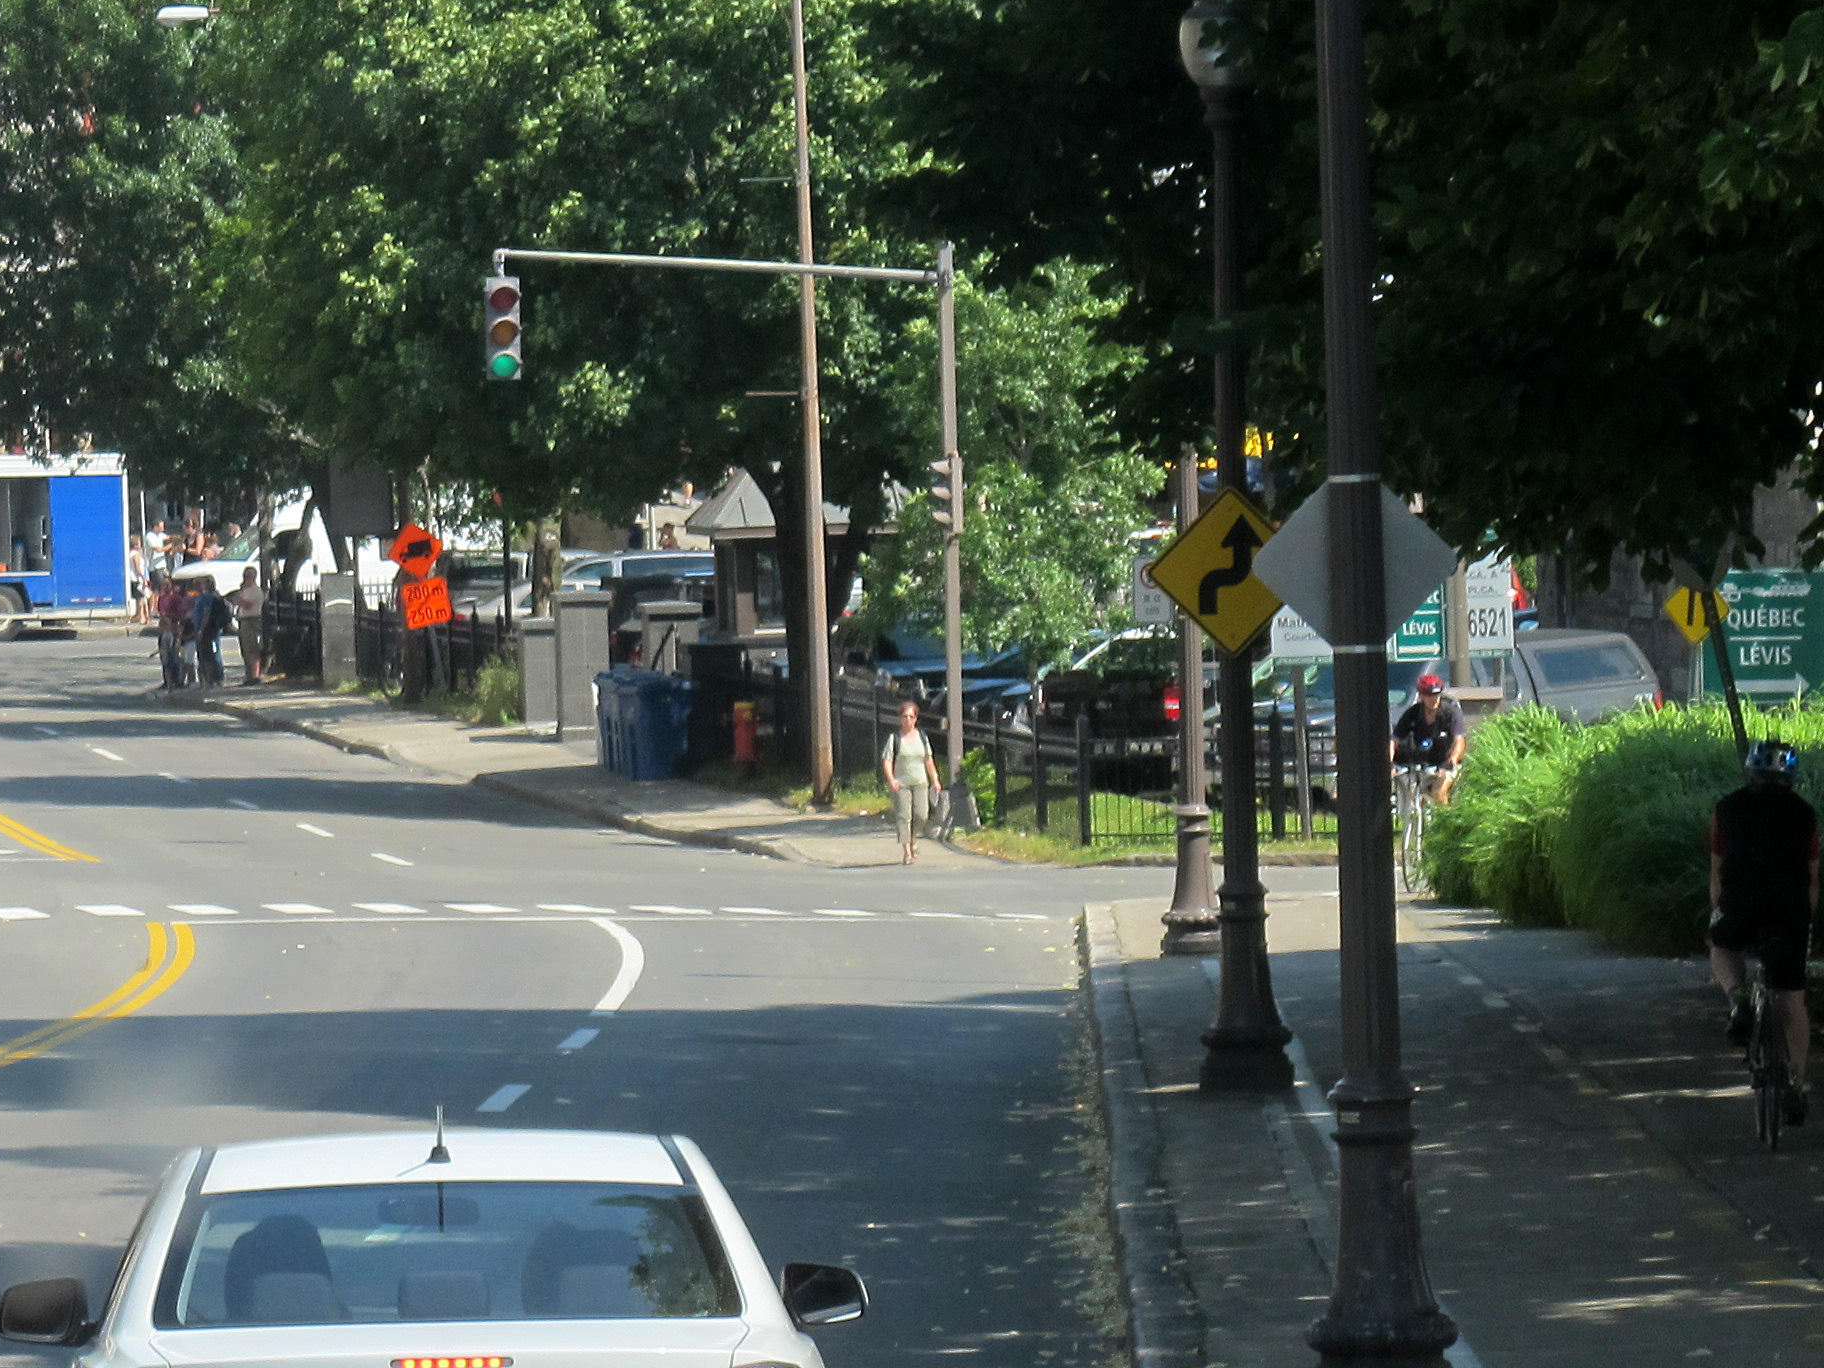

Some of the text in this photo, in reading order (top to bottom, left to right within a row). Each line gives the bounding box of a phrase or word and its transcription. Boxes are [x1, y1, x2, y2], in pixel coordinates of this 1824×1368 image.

[407, 583, 430, 601] 200
[1402, 619, 1437, 636] LÉVIS
[1467, 607, 1507, 637] 6521
[1727, 602, 1806, 631] QUÉBEC
[1739, 641, 1793, 666] LÉVIS
